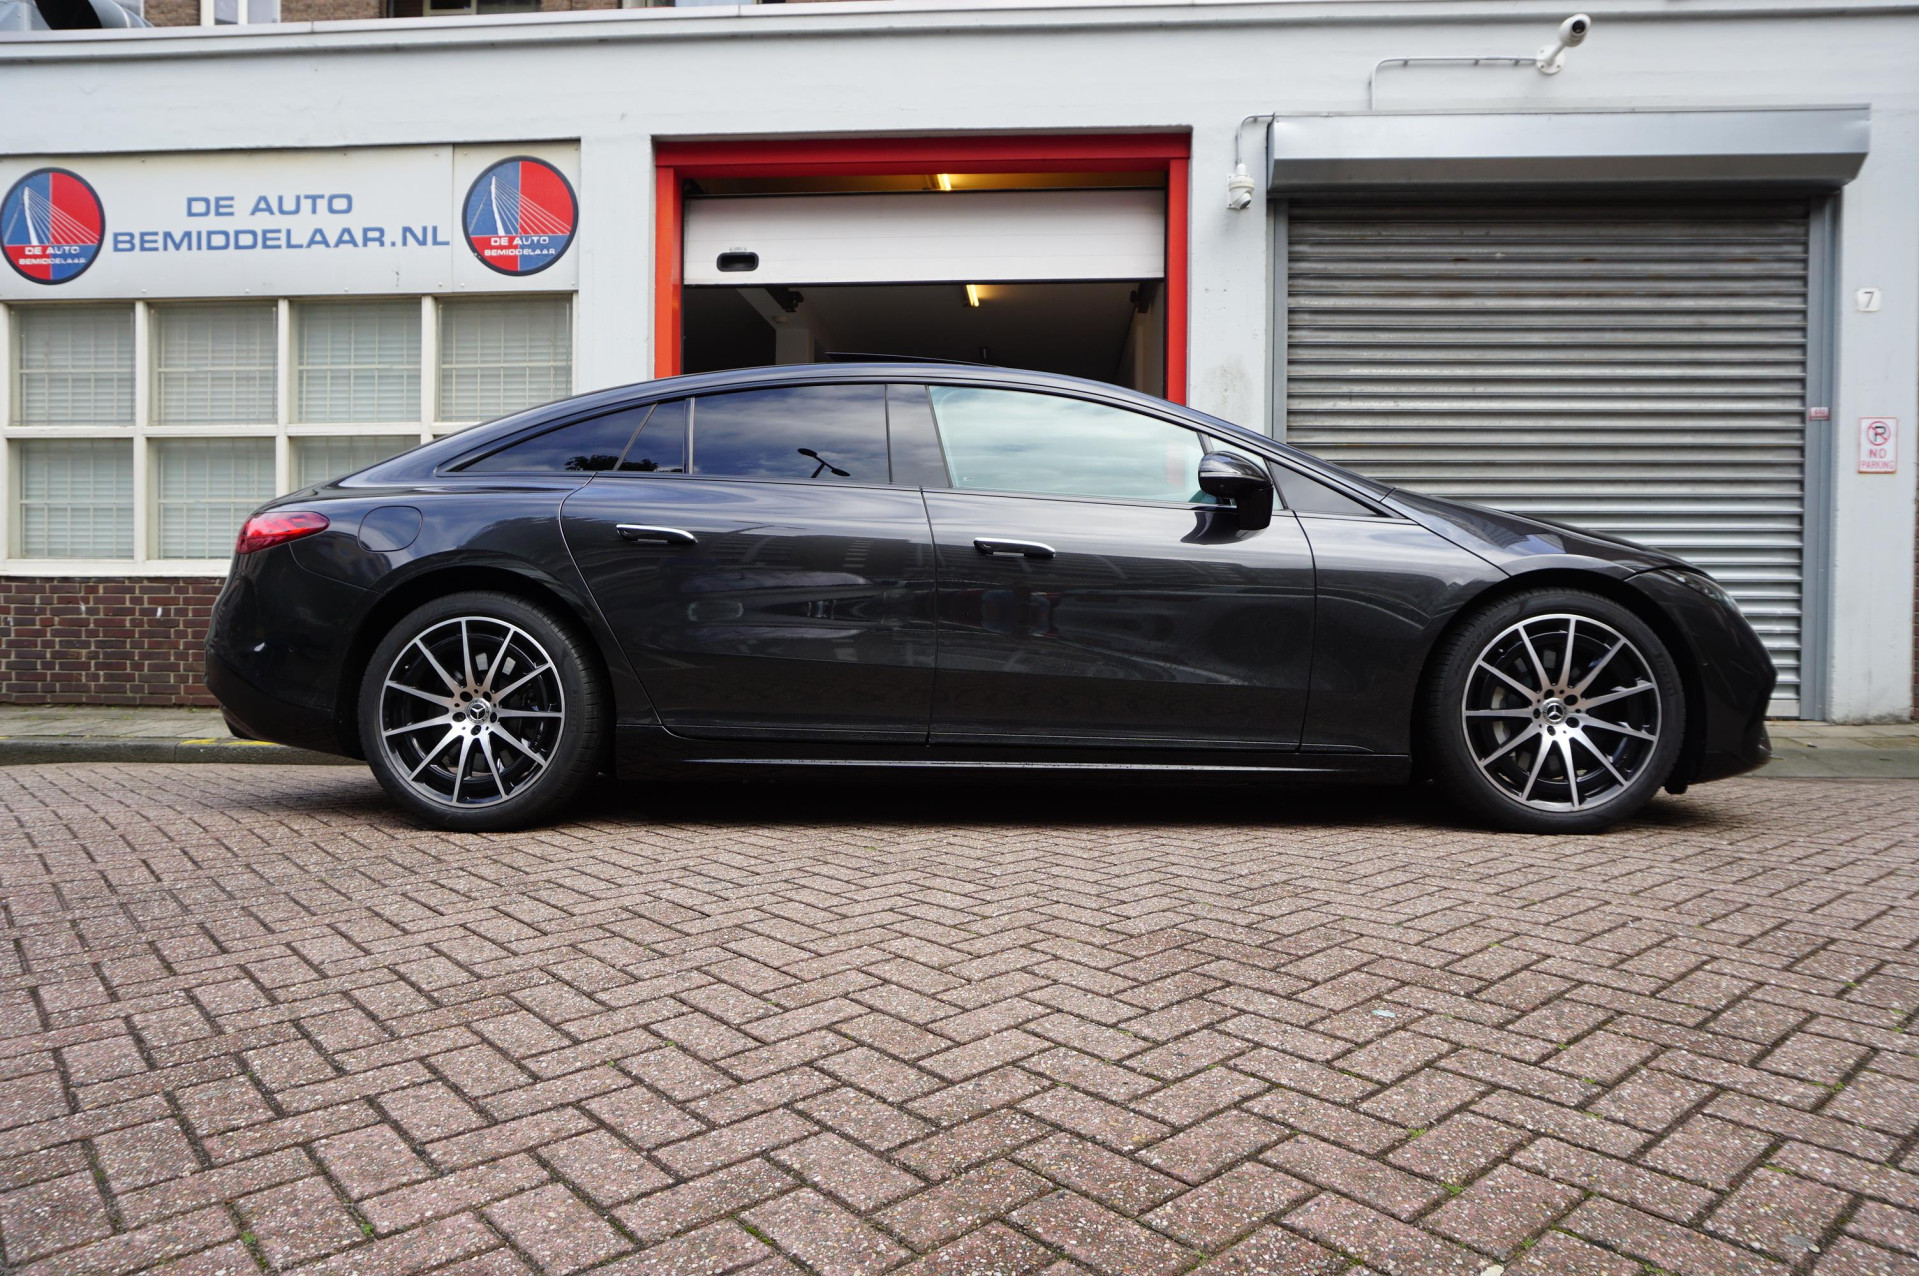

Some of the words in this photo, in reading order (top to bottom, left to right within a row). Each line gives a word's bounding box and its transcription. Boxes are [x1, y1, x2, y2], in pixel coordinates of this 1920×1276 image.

[186, 196, 235, 218] DE
[249, 193, 353, 216] AUTO
[112, 225, 451, 253] BEMIDDELAAR.NL
[490, 237, 509, 246] DE
[512, 236, 549, 245] AUTO
[24, 246, 43, 255] DE
[45, 245, 80, 255] AUTO
[484, 248, 556, 256] BEMIDDELAAR
[18, 257, 87, 265] BEMIDDELAAR
[1863, 291, 1875, 309] 7
[1868, 448, 1887, 459] NO
[1861, 460, 1895, 469] PARKING
